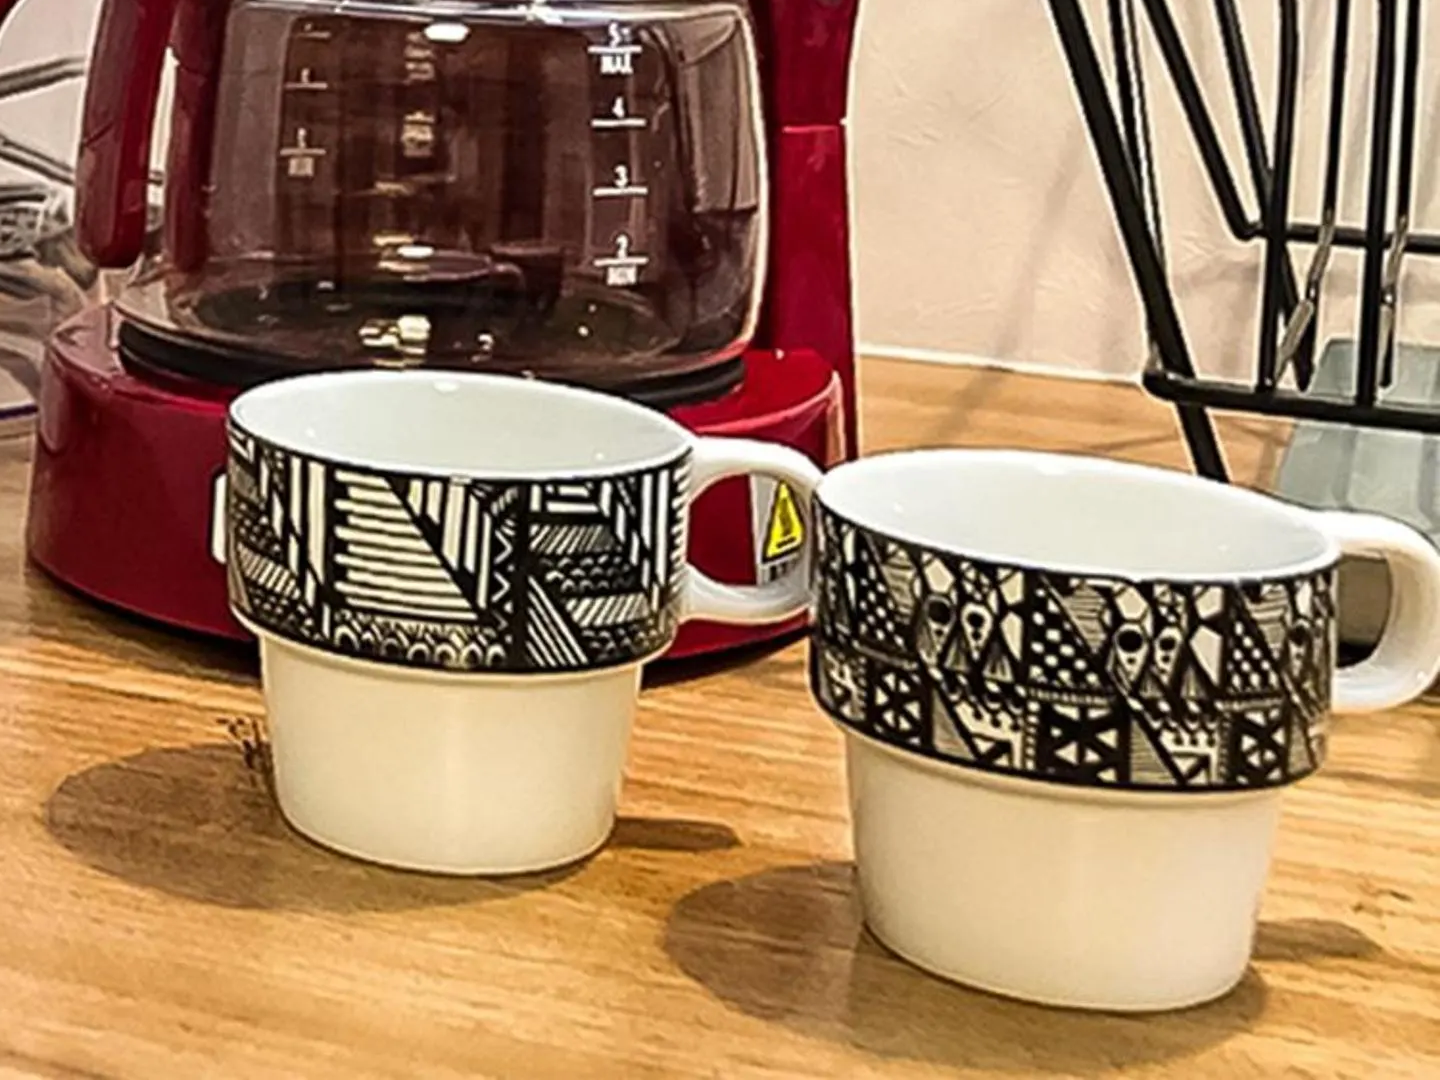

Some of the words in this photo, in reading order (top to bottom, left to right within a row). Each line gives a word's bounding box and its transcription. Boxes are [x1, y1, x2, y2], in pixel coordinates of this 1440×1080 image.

[612, 96, 625, 118] 4
[614, 164, 629, 187] 3
[615, 234, 629, 258] 2
